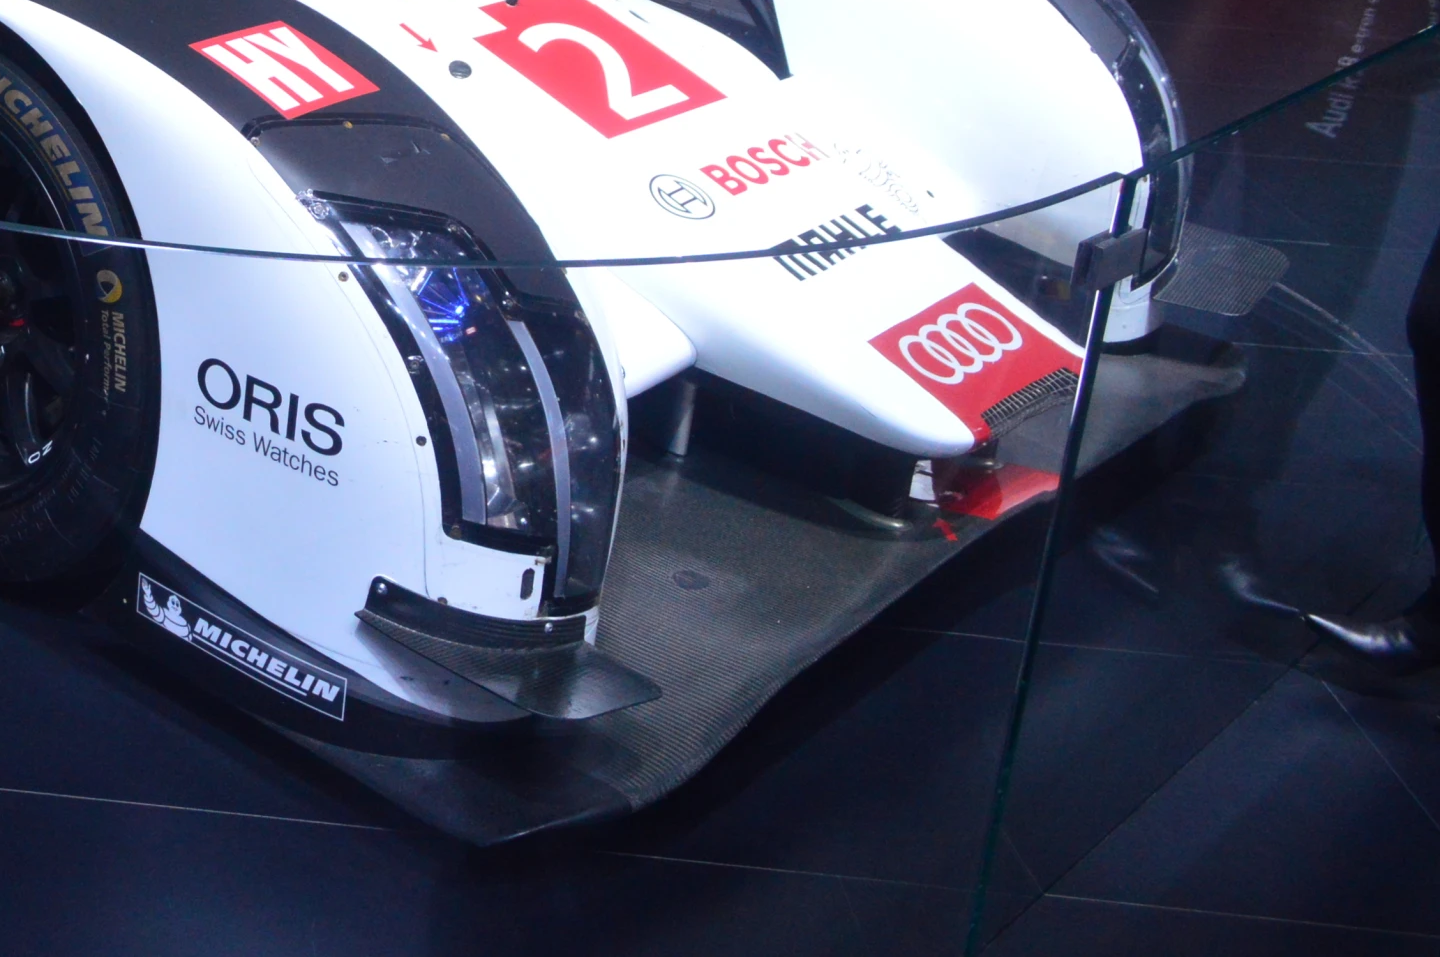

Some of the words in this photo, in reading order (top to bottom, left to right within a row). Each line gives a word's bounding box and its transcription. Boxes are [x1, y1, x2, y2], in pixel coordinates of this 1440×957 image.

[200, 25, 356, 113] HY
[517, 21, 691, 121] 2
[698, 132, 831, 197] BOSCH
[111, 311, 128, 393] MICHELIN
[193, 405, 246, 446] Swiss
[253, 431, 339, 487] Watches
[197, 357, 346, 457] ORIS
[193, 617, 341, 703] MICHELIN
